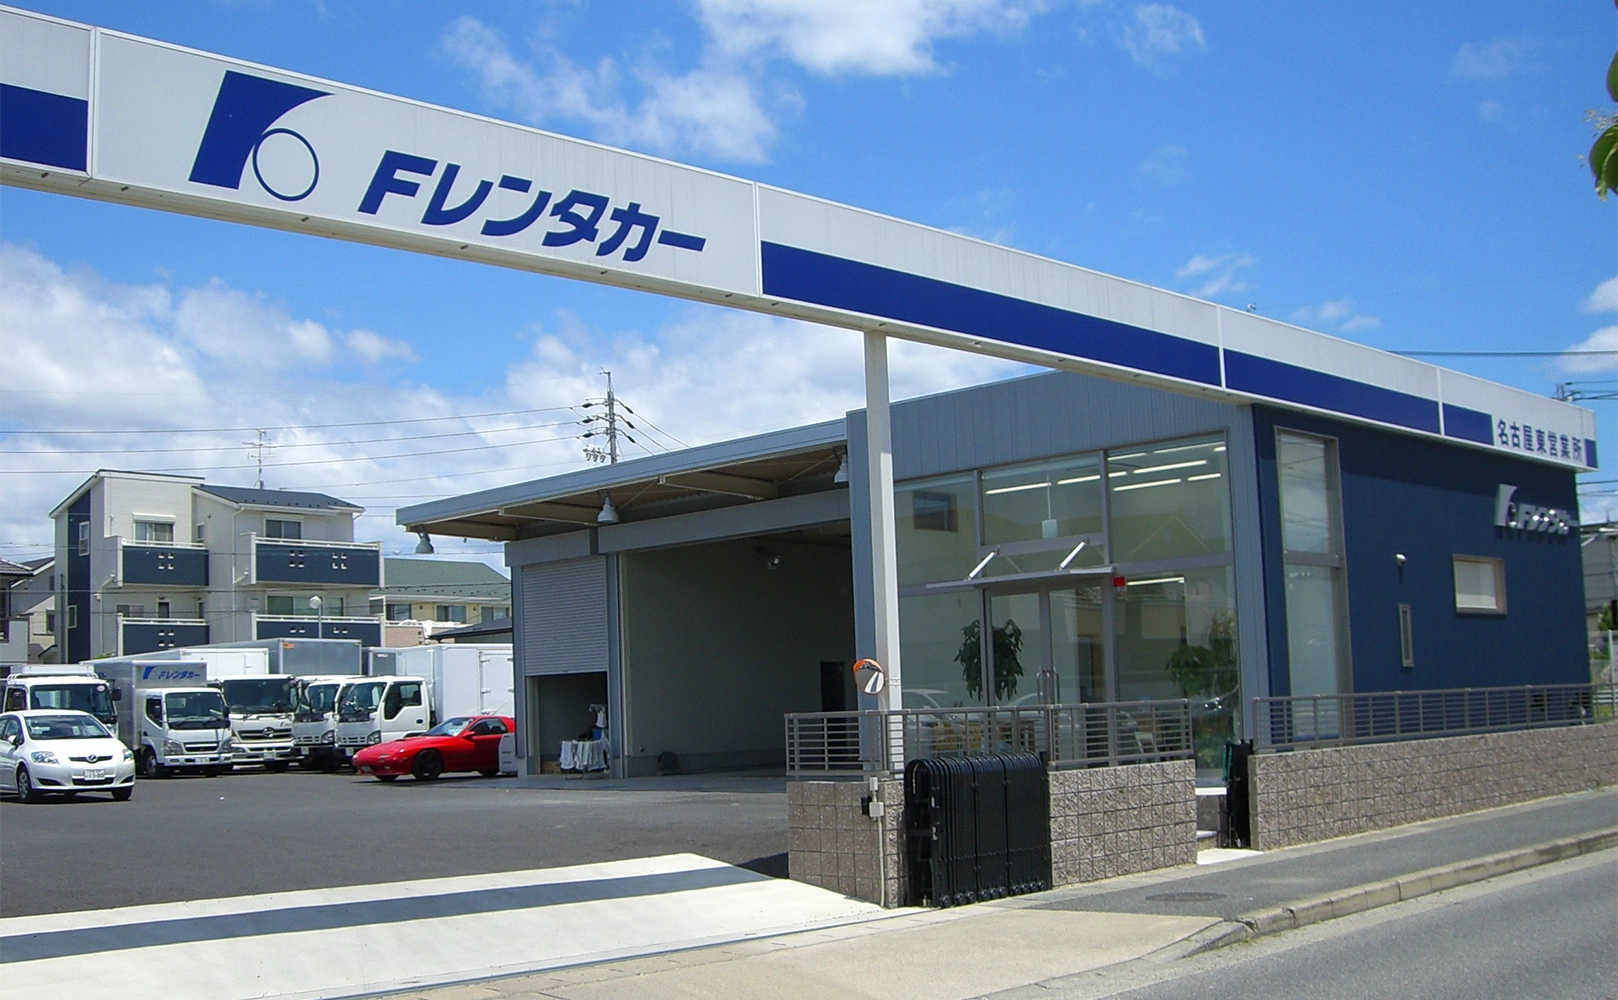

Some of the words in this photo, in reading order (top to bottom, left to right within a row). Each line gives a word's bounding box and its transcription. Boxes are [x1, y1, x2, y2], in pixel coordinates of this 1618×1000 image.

[357, 149, 707, 262] Fレンタカー
[1497, 417, 1582, 462] 名古屋東営業所
